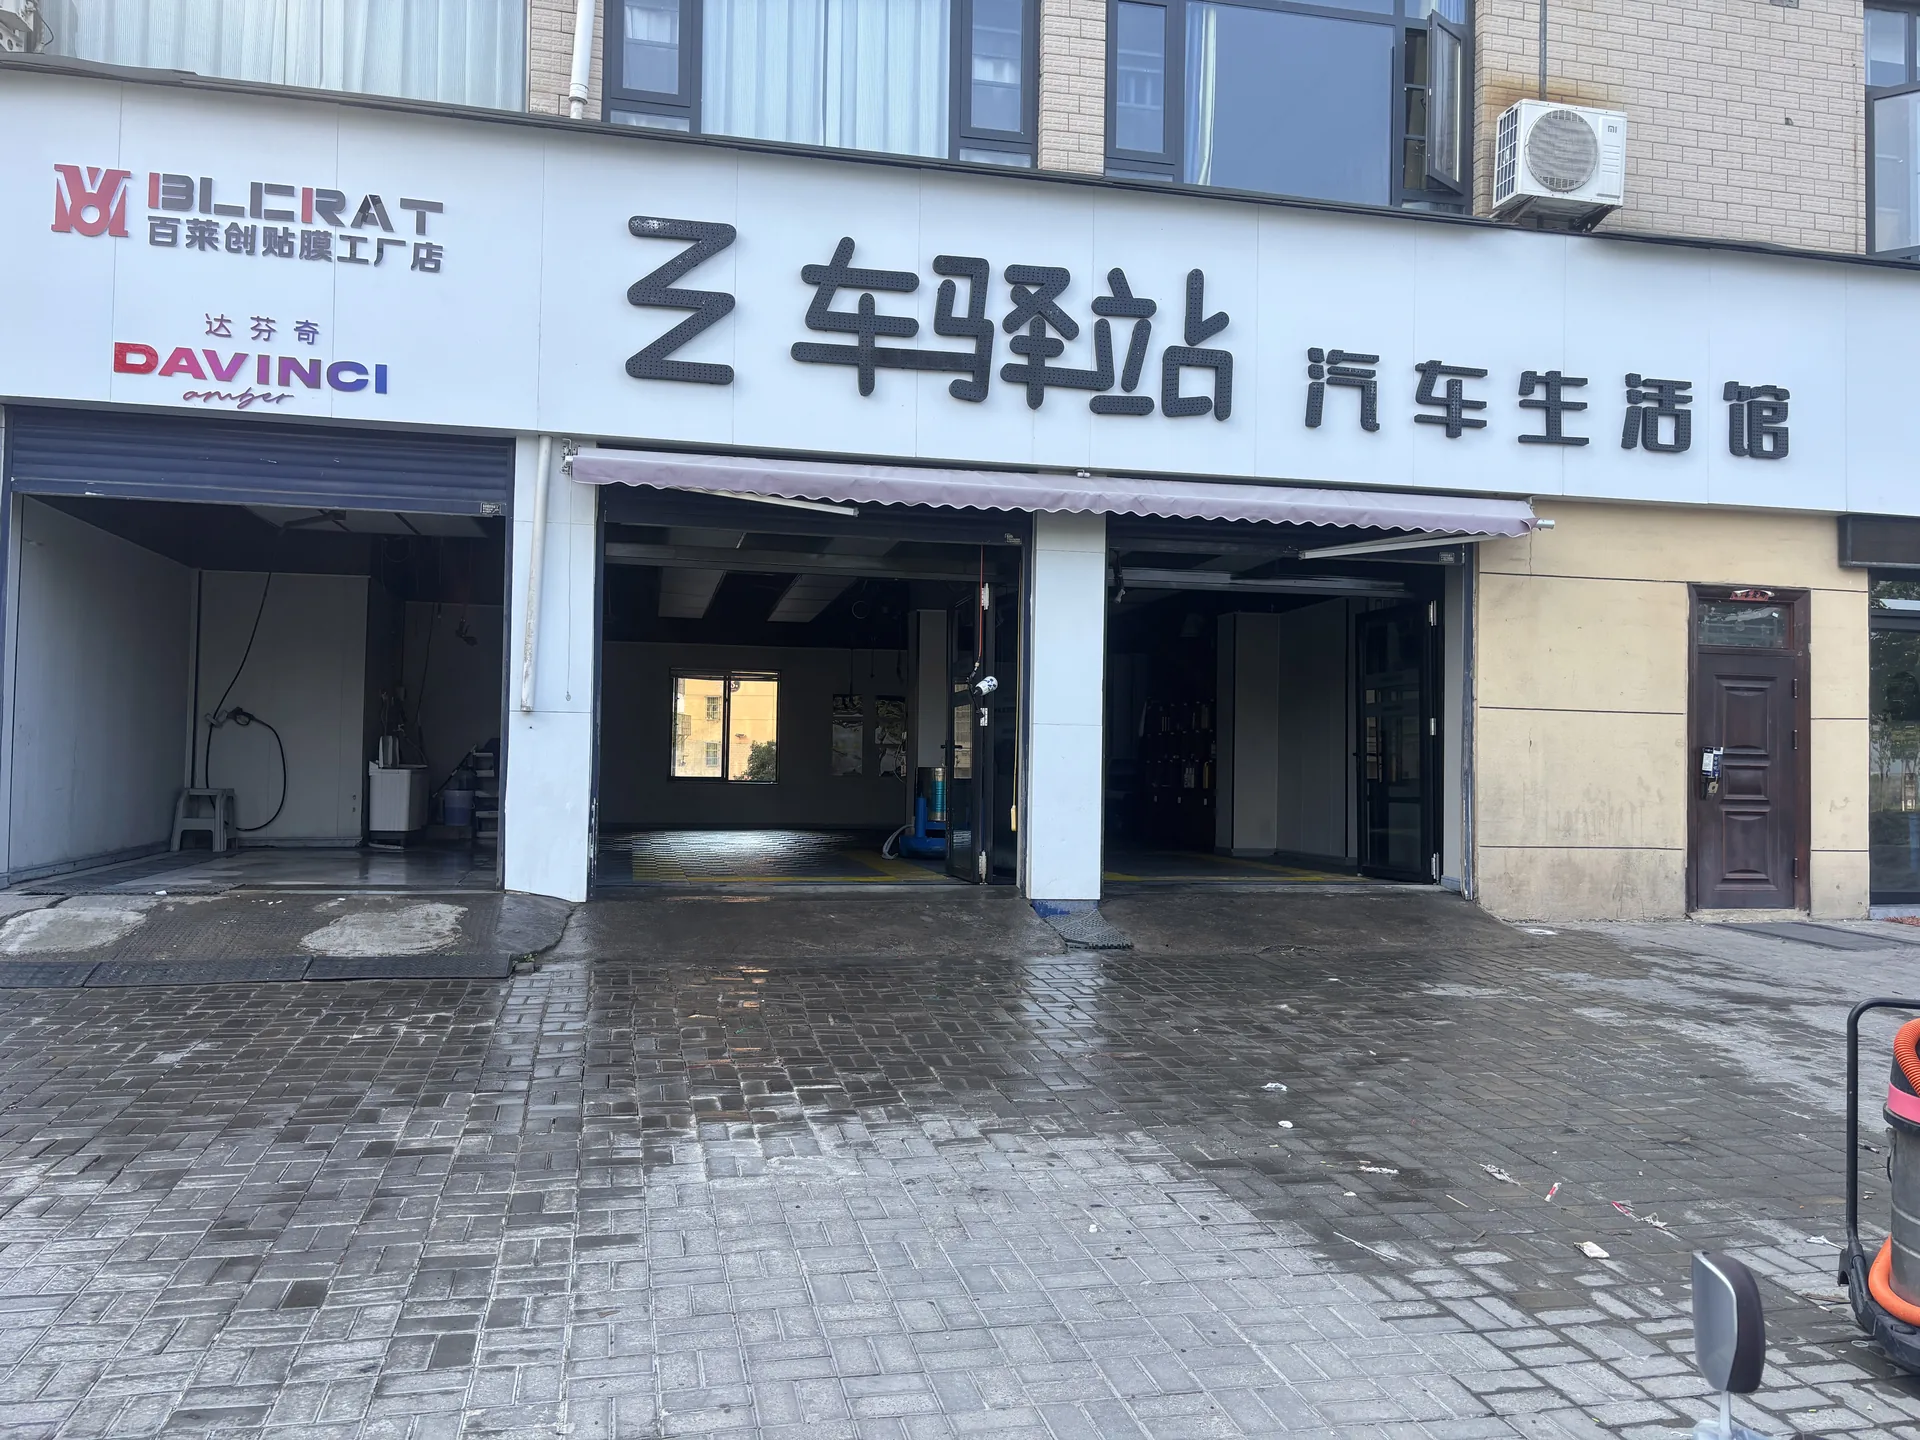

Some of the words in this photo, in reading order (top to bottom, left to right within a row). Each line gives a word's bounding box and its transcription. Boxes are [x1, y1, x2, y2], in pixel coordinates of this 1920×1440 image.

[148, 172, 444, 236] BLCRAT
[148, 215, 444, 273] 百莱创贴膜工厂店
[204, 313, 320, 345] 达芬奇
[790, 236, 1234, 422] 车驿站
[1305, 346, 1791, 460] 汽车生活馆
[113, 341, 388, 395] DAVINCI
